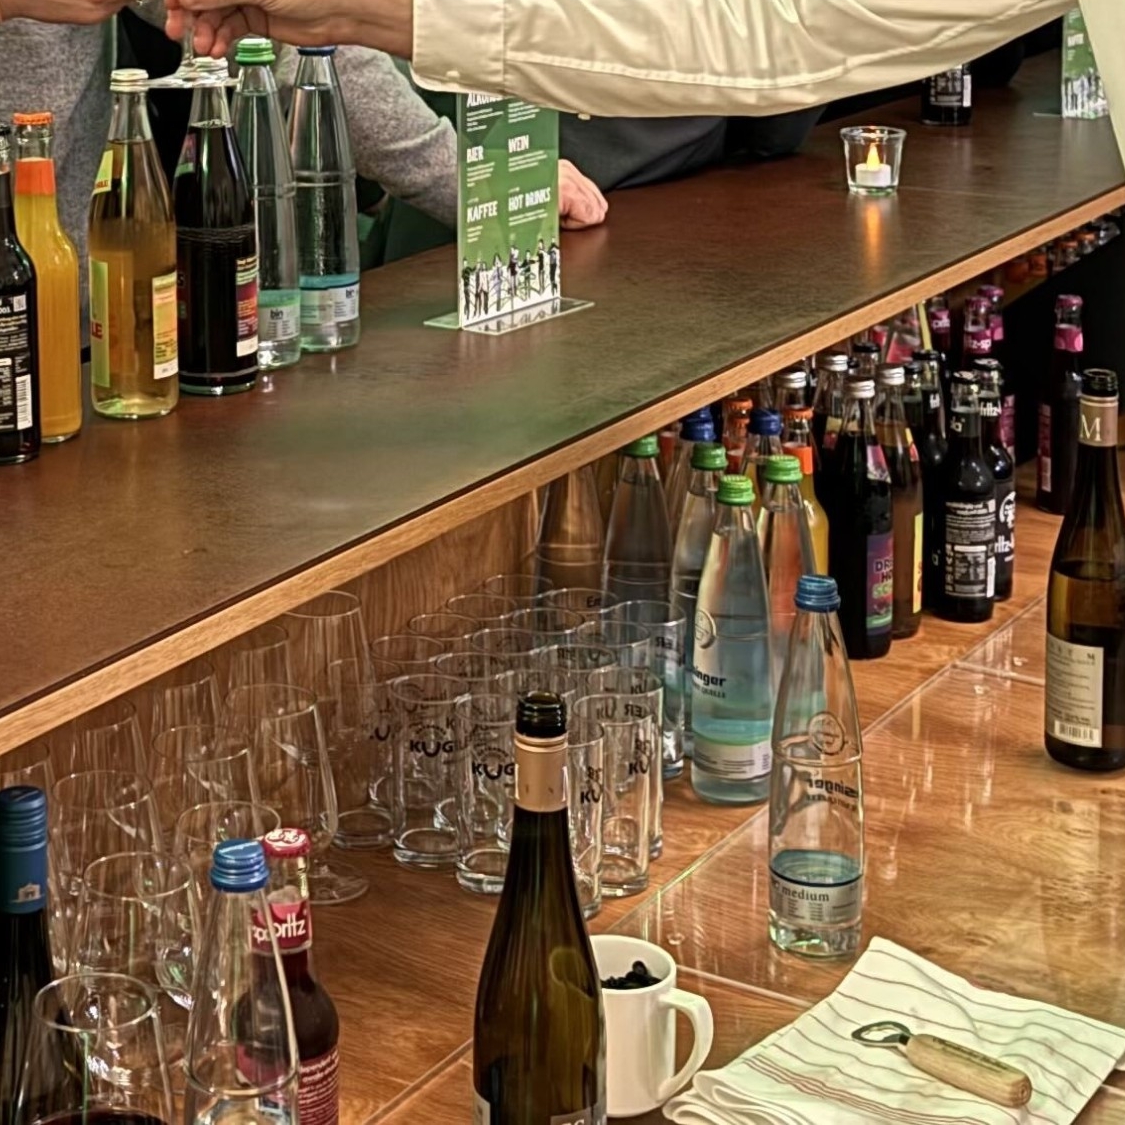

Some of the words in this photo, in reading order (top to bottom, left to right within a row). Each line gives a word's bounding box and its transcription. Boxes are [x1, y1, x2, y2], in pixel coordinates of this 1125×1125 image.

[467, 145, 484, 163] BIER
[508, 135, 530, 153] WEIN
[508, 194, 524, 211] HOT
[525, 187, 551, 208] DRINKS
[467, 200, 498, 223] KAFFEE
[1080, 414, 1101, 440] M
[781, 885, 830, 902] medium
